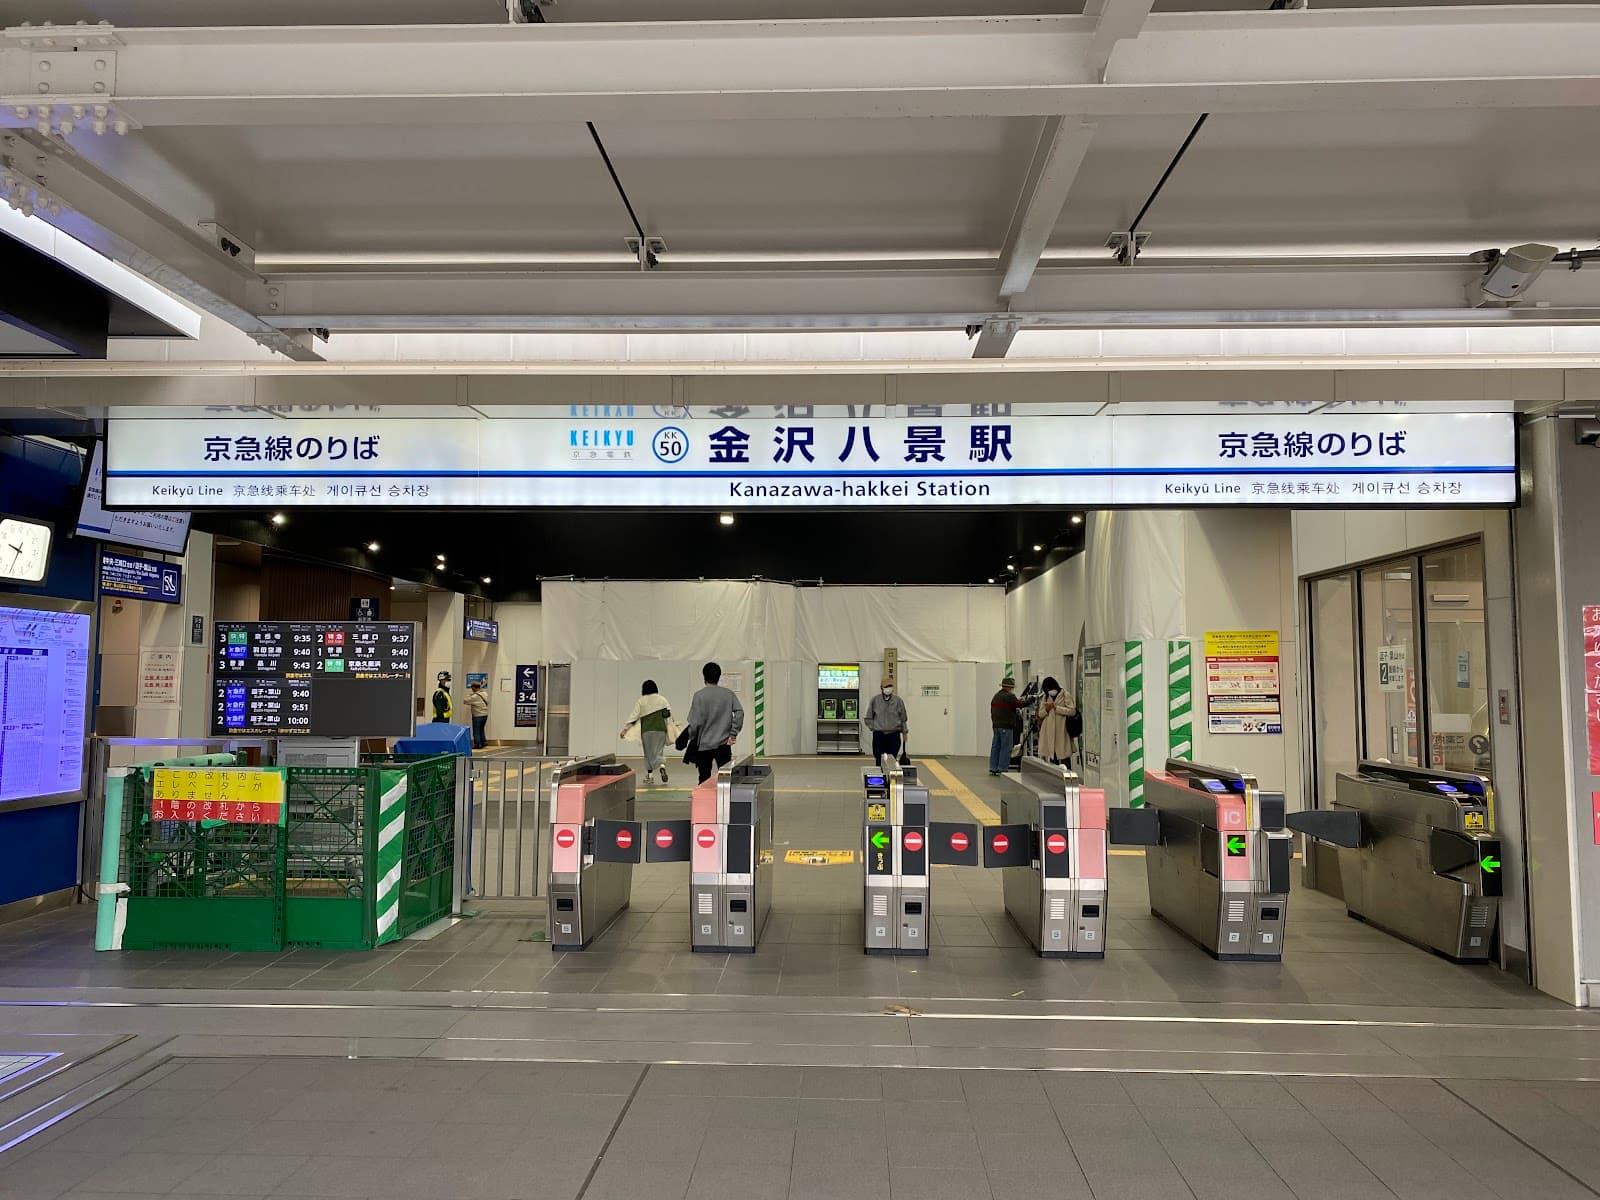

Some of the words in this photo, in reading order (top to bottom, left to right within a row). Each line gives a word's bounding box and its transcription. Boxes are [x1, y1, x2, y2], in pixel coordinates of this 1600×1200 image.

[570, 430, 634, 446] KEIKYU
[709, 425, 1013, 464] 金沢八景駅
[1218, 431, 1407, 458] 京急線のりば
[203, 435, 380, 462] 京急線のりば
[660, 441, 682, 456] 50
[152, 485, 194, 498] Keikyū
[198, 485, 224, 497] Line
[233, 485, 316, 498] 京急线乘车处
[326, 484, 382, 497] 게이큐선
[388, 484, 430, 497] 승차장
[730, 481, 909, 497] Kanazawa-hakkei
[917, 481, 990, 497] Station
[1165, 482, 1210, 497] Keikyū
[1214, 482, 1241, 494] Line
[1252, 482, 1340, 495] 京急线乘车处
[1351, 481, 1411, 495] 게이큐선
[1417, 481, 1463, 495] 승차장
[220, 634, 226, 642] 3
[317, 634, 324, 642] 2
[391, 635, 409, 643] 9:37
[219, 647, 226, 656] 4
[293, 648, 311, 656] 9:40
[317, 648, 322, 656] 1
[391, 648, 409, 656] 9:40
[219, 661, 226, 669] 3
[316, 661, 323, 669] 2
[391, 662, 408, 670] 9:46
[1381, 664, 1388, 682] 2
[218, 689, 225, 698] 2
[217, 702, 224, 711] 2
[217, 716, 224, 725] 2
[287, 717, 309, 725] 10:00
[156, 771, 262, 781] ここの改札内に
[156, 780, 262, 792] エレベーターが
[159, 800, 261, 812] 1階の改札から
[154, 810, 271, 823] お入りください。
[1224, 811, 1241, 825] IC
